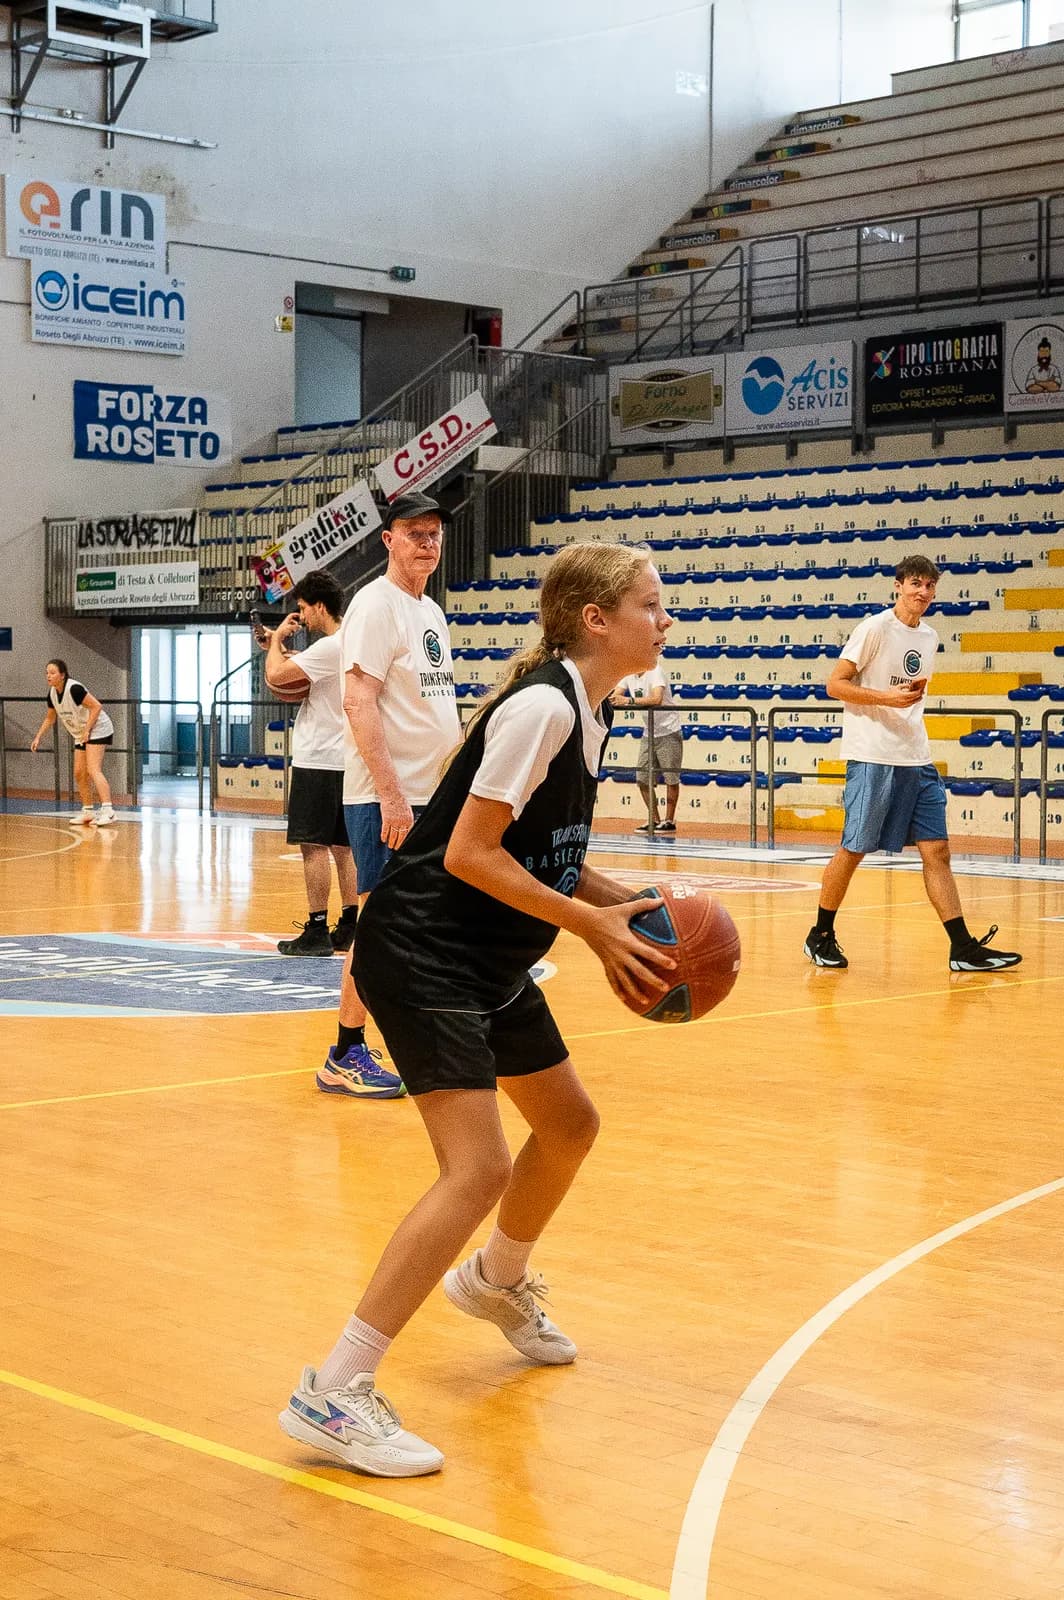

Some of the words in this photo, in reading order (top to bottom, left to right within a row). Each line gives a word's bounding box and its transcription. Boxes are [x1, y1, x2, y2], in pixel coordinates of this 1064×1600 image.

[789, 119, 841, 135] dimarcolor
[729, 174, 780, 190] dimarcolor
[27, 229, 82, 240] FOTOVOLTAICO
[125, 241, 155, 250] AZIENDA
[665, 232, 717, 248] dimarcolor
[73, 272, 185, 321] iceim
[35, 314, 69, 323] BONIFICHE
[72, 317, 102, 327] AMIANTO
[106, 320, 144, 331] COPERTURE
[146, 324, 185, 334] INDUSTRIALI
[35, 329, 61, 339] Roseto
[63, 331, 81, 342] Degli
[82, 333, 109, 344] Abruzzi
[110, 336, 125, 346] (TE)
[134, 339, 185, 351] www.iceim.it
[900, 334, 998, 366] TIPOLITOGRAFIA
[786, 357, 849, 396] Acis
[900, 359, 998, 379] ROSETANA
[643, 384, 688, 399] Forno
[900, 388, 925, 399] OFFSET
[931, 383, 964, 395] DIGITALE
[98, 389, 208, 426] FORZA
[788, 392, 849, 411] SERVIZI
[872, 402, 904, 414] EDITORIA
[911, 397, 957, 409] PACKAGING
[964, 393, 995, 406] GRAFICA
[756, 417, 820, 431] www.acisservizi.it
[86, 423, 220, 460] ROSETO
[394, 414, 472, 479] C.S.D.
[78, 521, 94, 548] LA
[288, 500, 357, 564] grafika
[312, 509, 368, 561] mente
[645, 531, 654, 539] 57
[672, 529, 681, 537] 56
[698, 528, 708, 536] 55
[727, 526, 736, 534] 54
[755, 525, 765, 533] 53
[785, 524, 795, 532] 52
[815, 522, 824, 531] 51
[845, 521, 855, 529] 50
[876, 519, 886, 528] 49
[908, 518, 919, 526] 48
[941, 516, 951, 524] 47
[973, 514, 984, 522] 46
[1008, 512, 1019, 521] 45
[1043, 511, 1053, 520] 44
[686, 563, 696, 571] 54
[715, 563, 725, 571] 53
[744, 562, 754, 570] 52
[775, 561, 784, 569] 51
[805, 560, 816, 568] 50
[838, 558, 847, 567] 49
[869, 557, 880, 565] 48
[968, 553, 980, 562] 45
[1002, 552, 1014, 561] 44
[117, 575, 125, 586] di
[126, 574, 146, 586] Testa
[149, 574, 155, 584] &
[77, 596, 99, 606] Agenzia
[100, 595, 128, 605] Generale
[129, 594, 150, 604] Roseto
[151, 593, 167, 604] degli
[169, 591, 196, 601] Abruzzi
[729, 596, 739, 604] 51
[792, 594, 802, 602] 49
[823, 593, 834, 601] 48
[857, 592, 867, 601] 47
[958, 590, 970, 598] 44
[716, 636, 727, 644] 50
[748, 635, 759, 643] 49
[779, 635, 790, 643] 48
[813, 634, 823, 643] 47
[671, 672, 681, 680] 50
[702, 672, 713, 680] 49
[735, 672, 746, 681] 48
[766, 672, 777, 680] 47
[800, 672, 811, 680] 46
[624, 712, 635, 720] 50
[687, 712, 698, 721] 48
[720, 713, 731, 721] 47
[788, 714, 799, 722] 45
[824, 714, 835, 722] 44
[705, 754, 717, 763] 46
[741, 755, 751, 764] 45
[776, 757, 787, 765] 44
[969, 761, 983, 770] 42
[689, 799, 700, 808] 45
[725, 801, 736, 810] 44
[961, 810, 973, 820] 41
[1047, 815, 1062, 824] 39
